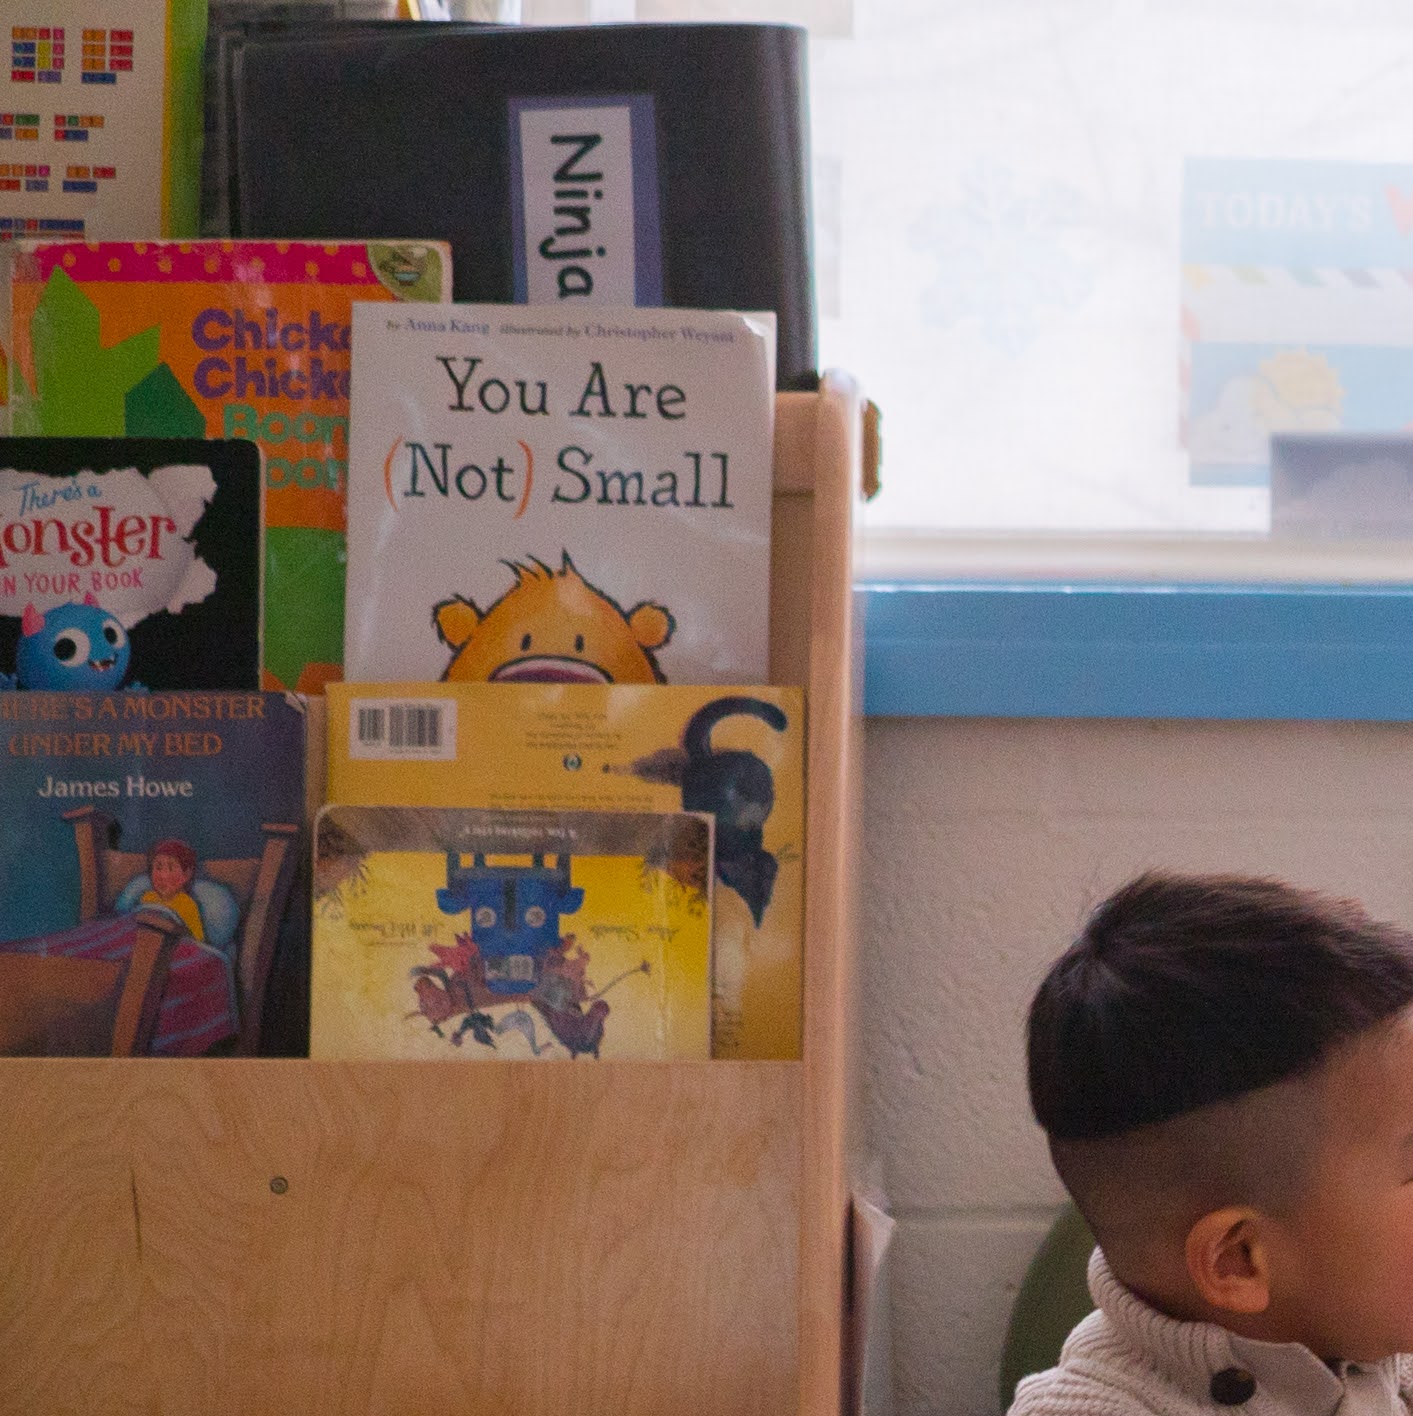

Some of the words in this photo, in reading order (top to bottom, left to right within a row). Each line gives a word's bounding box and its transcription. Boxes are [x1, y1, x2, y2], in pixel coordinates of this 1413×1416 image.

[539, 133, 606, 299] Ninja
[1198, 191, 1373, 232] TODAY'S
[436, 355, 549, 416] You
[569, 361, 687, 420] Are
[86, 484, 102, 498] a
[384, 436, 534, 520] (Not)
[551, 444, 735, 509] Small
[0, 505, 177, 569] onster
[24, 571, 81, 595] YOUR
[91, 567, 144, 593] BOOK
[99, 696, 119, 719] A
[124, 694, 266, 720] MONSTER
[8, 731, 111, 757] UNDER
[118, 732, 160, 757] MY
[165, 732, 223, 757] BED
[37, 776, 120, 798] James
[126, 775, 193, 798] Howe
